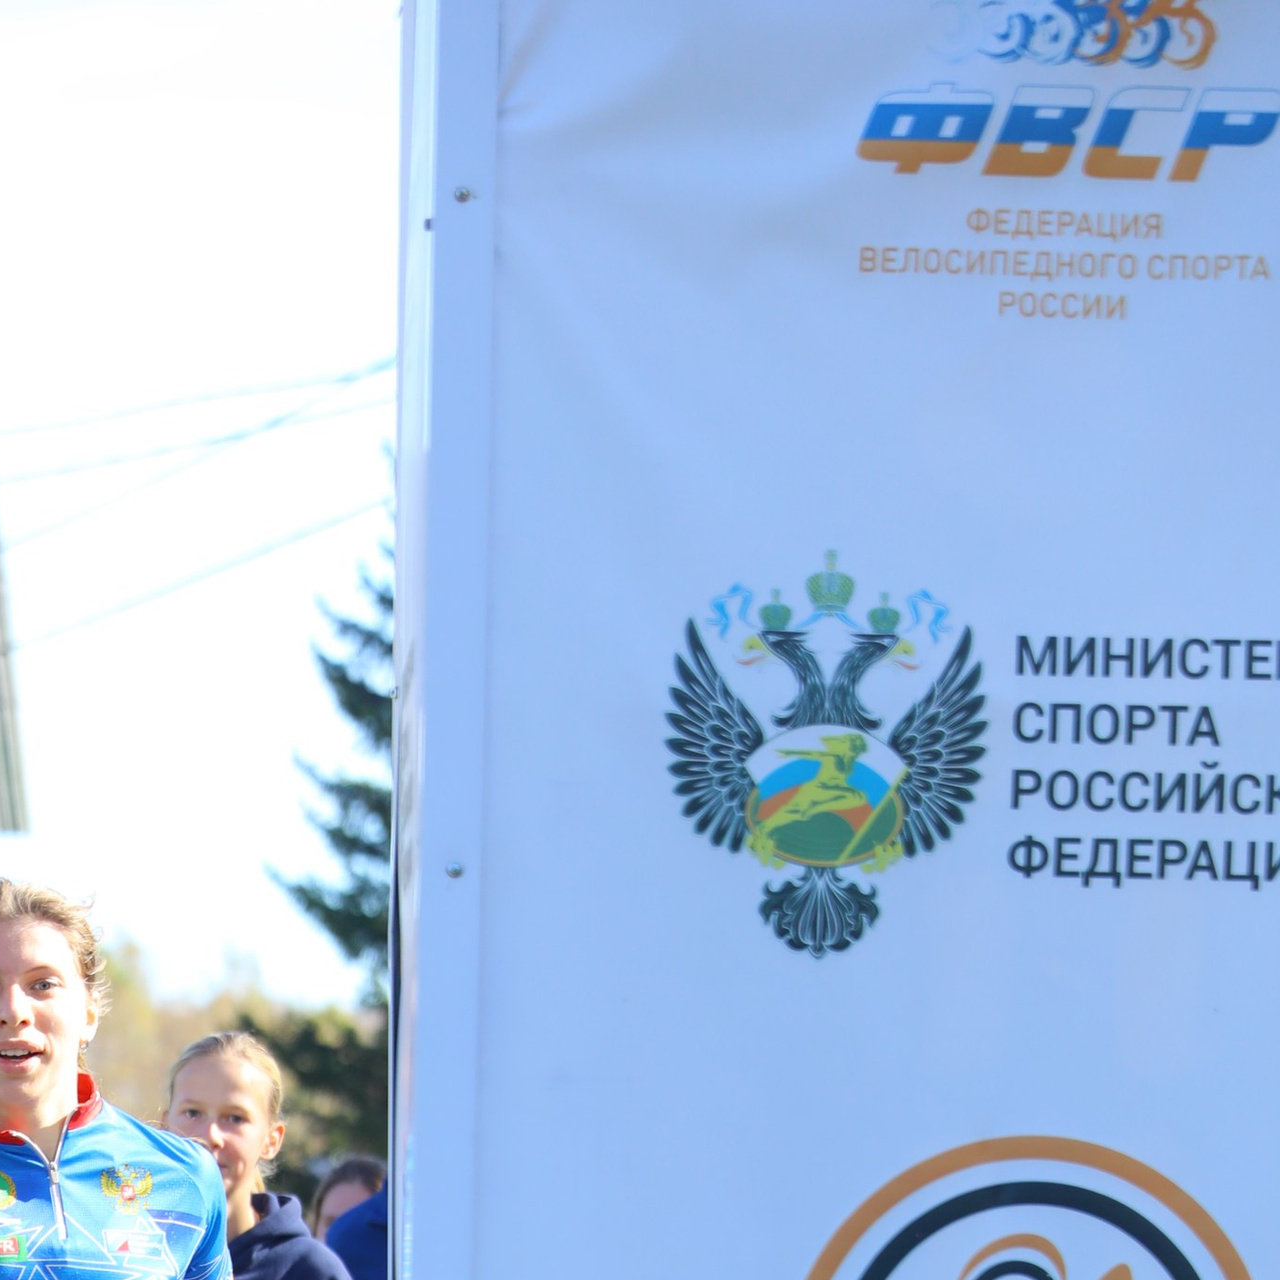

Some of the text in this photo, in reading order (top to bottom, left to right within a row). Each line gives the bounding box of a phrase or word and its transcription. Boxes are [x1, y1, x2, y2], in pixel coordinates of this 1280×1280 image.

[857, 83, 1280, 182] ФВСР
[966, 207, 1164, 241] ФЕДЕРАЦИЯ
[858, 246, 1271, 281] ВЕЛОСИПЕДНОГО СПОРТА
[998, 291, 1128, 320] РОССИИ
[1015, 635, 1280, 681] МИНИСТЕ
[1012, 702, 1221, 748] СПОРТА
